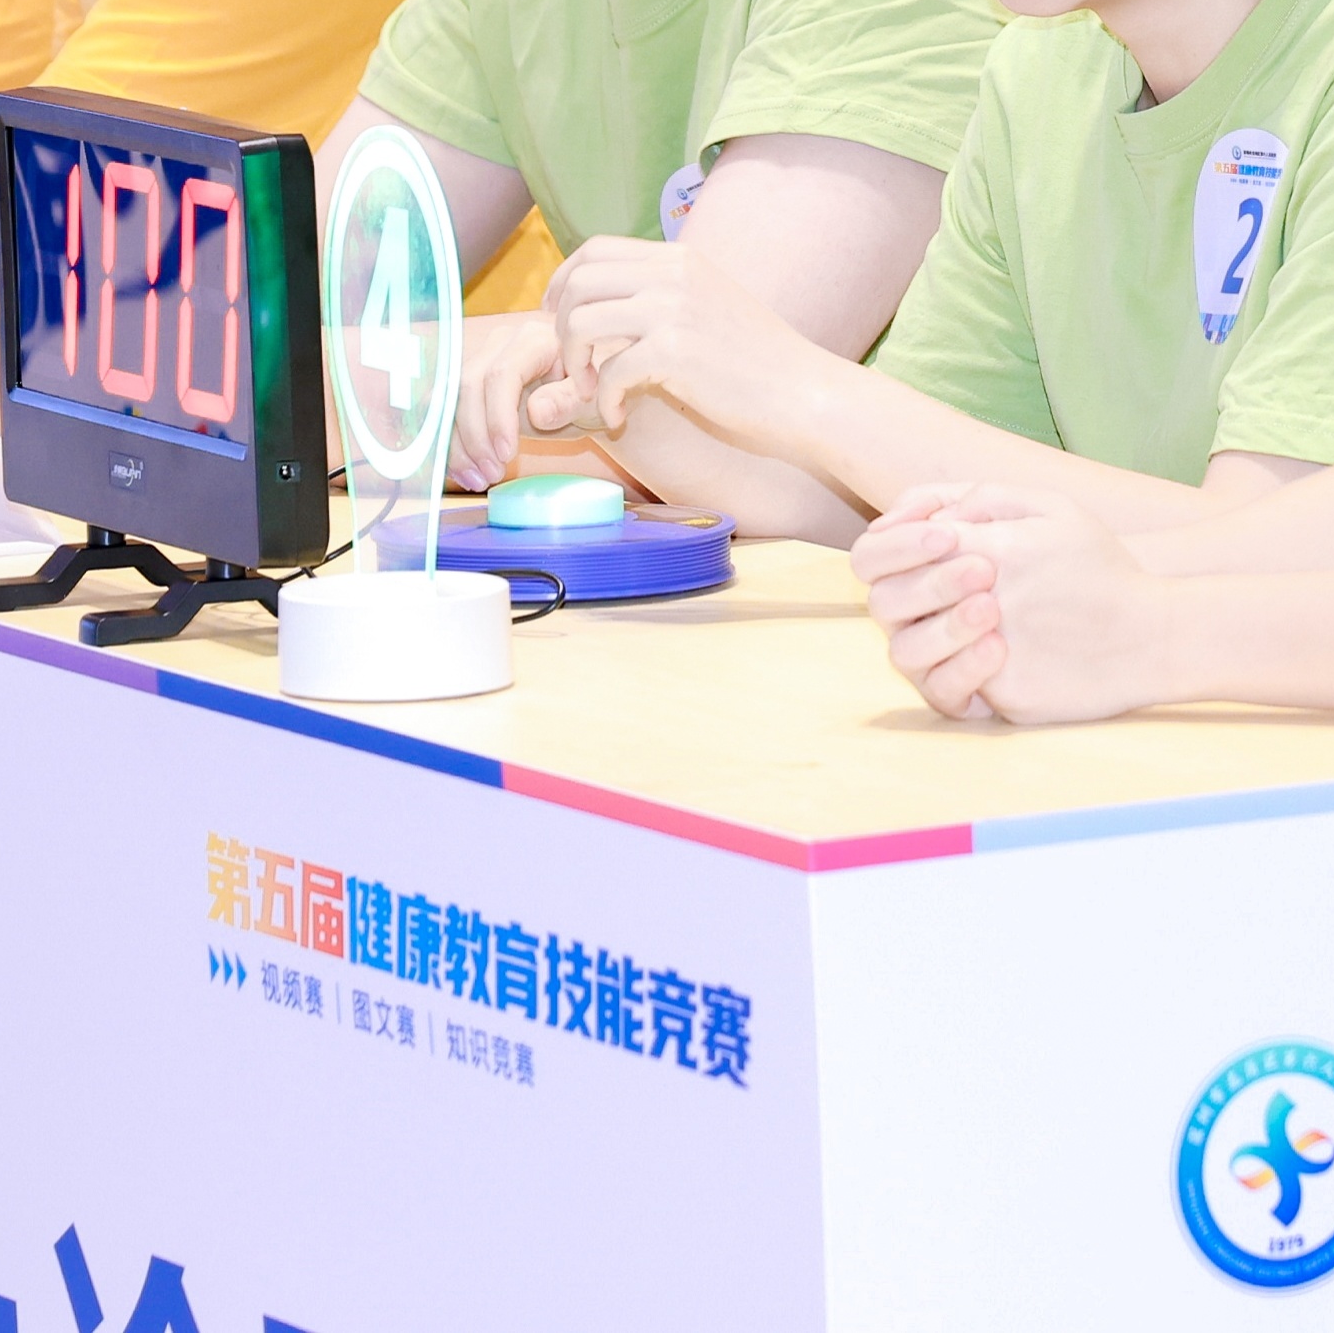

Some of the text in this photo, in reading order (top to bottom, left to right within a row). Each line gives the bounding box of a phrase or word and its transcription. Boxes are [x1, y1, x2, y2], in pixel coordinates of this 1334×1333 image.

[64, 160, 240, 423] 100
[361, 205, 426, 411] 4
[1220, 197, 1264, 295] 2
[205, 830, 751, 1090] 第五届健康教育技能竞赛
[261, 960, 536, 1089] 视频赛 图文赛 知识竞赛
